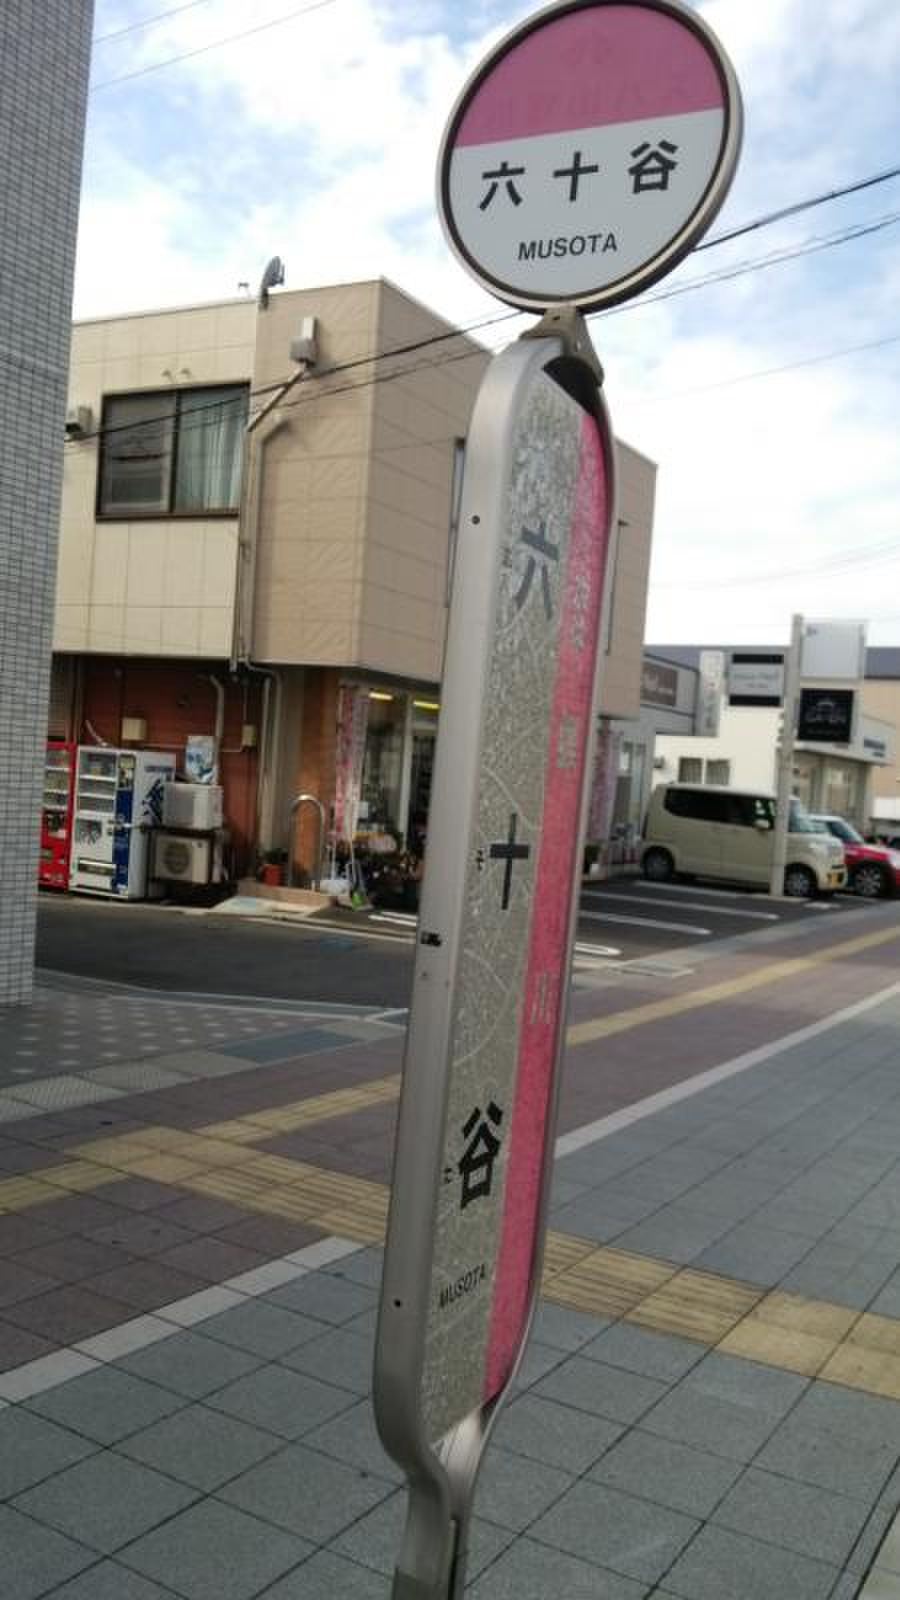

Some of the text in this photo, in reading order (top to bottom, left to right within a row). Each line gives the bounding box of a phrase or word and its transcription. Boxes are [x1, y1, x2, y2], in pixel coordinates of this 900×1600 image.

[478, 140, 679, 211] 六十谷
[518, 233, 618, 261] MUSOTA
[457, 521, 560, 1209] 六十谷
[439, 1264, 487, 1308] MUSOTA
